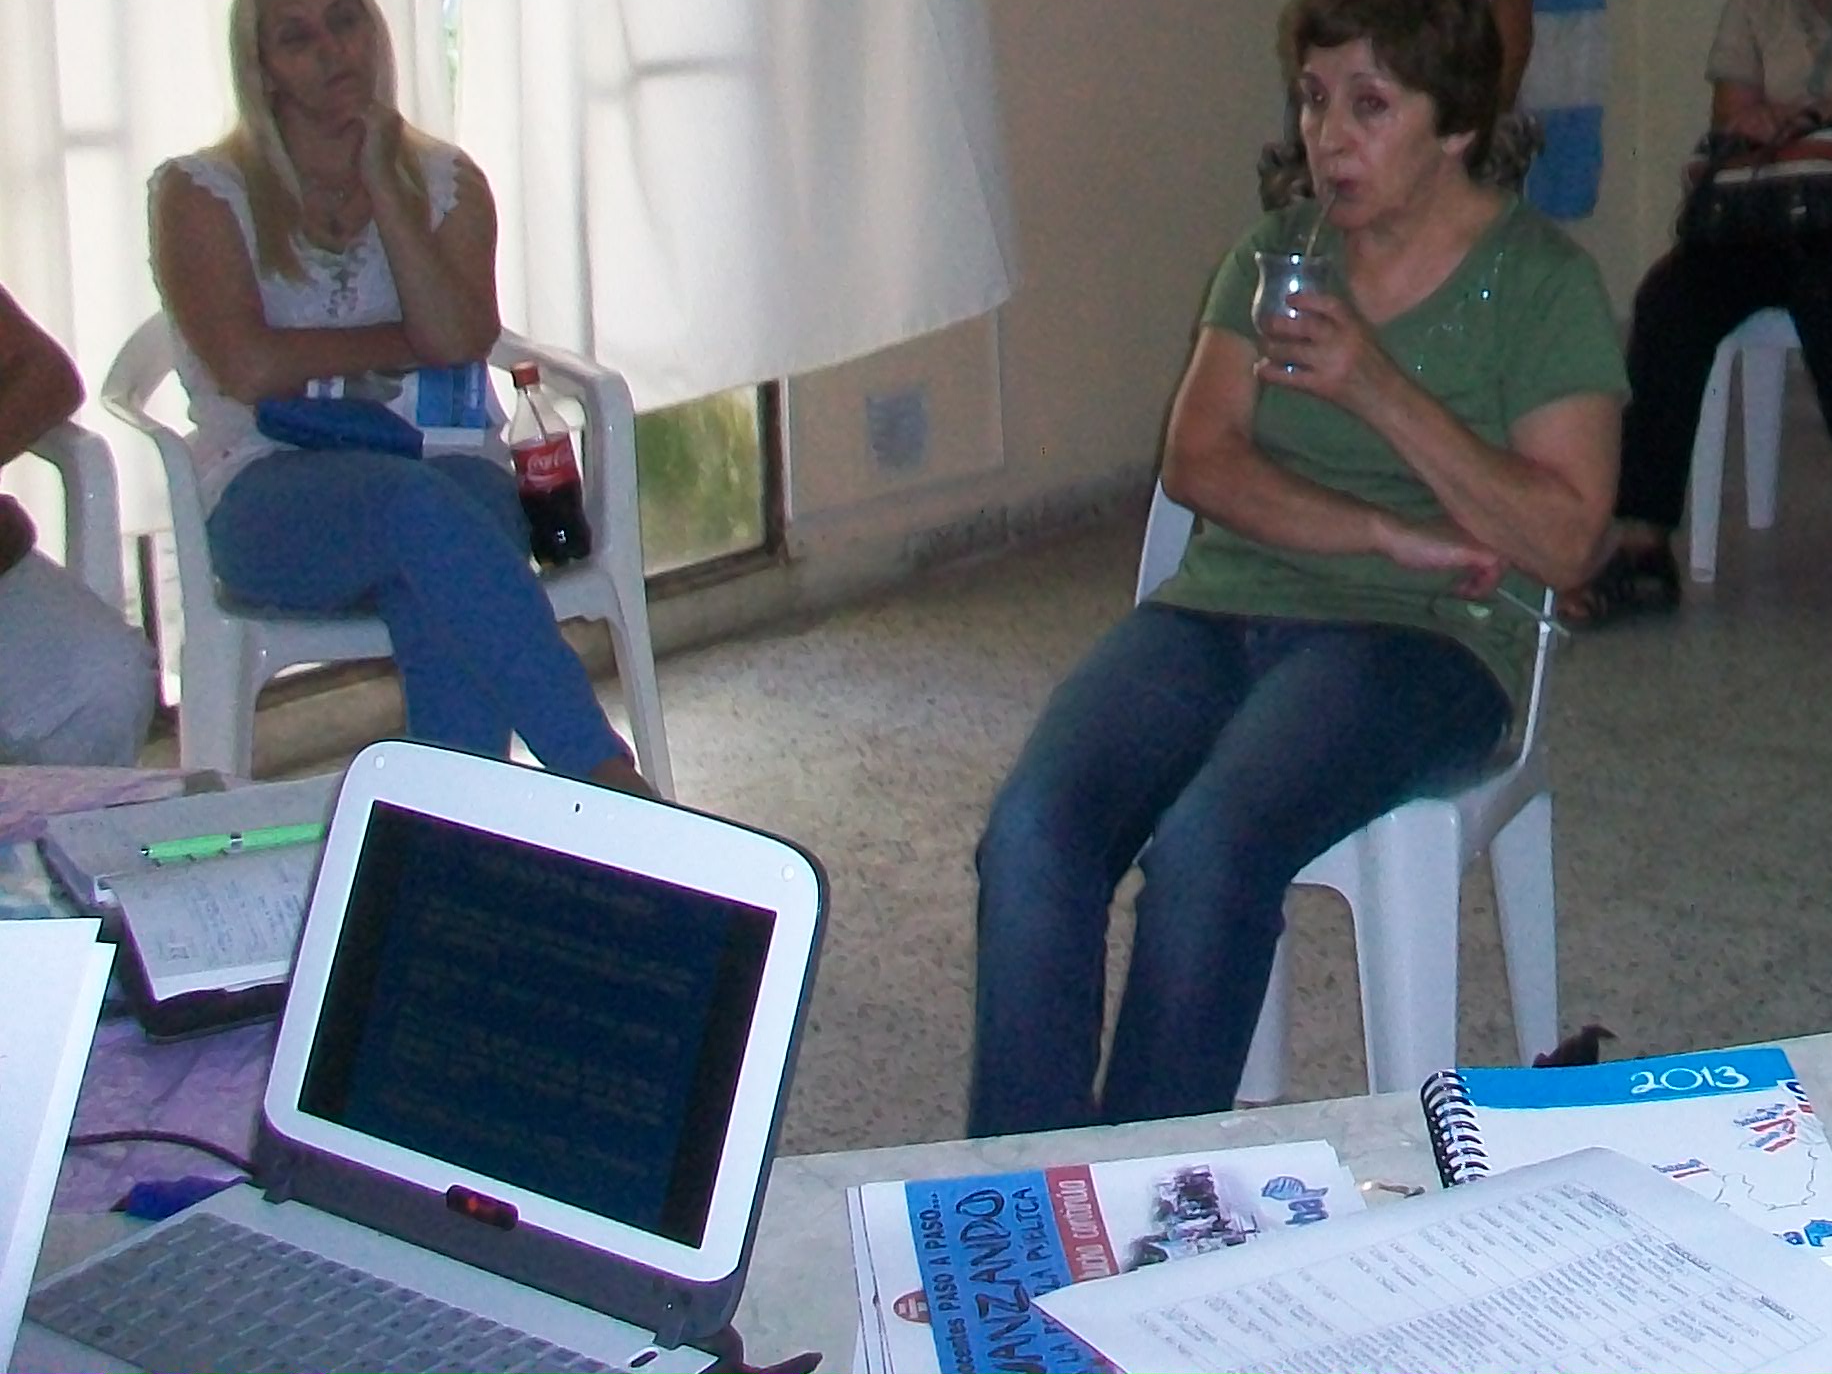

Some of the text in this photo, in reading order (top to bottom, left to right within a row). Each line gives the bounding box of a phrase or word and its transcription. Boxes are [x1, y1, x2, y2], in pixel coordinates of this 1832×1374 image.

[1630, 1064, 1750, 1094] 2013
[930, 1256, 953, 1267] A
[937, 1274, 965, 1312] PASO
